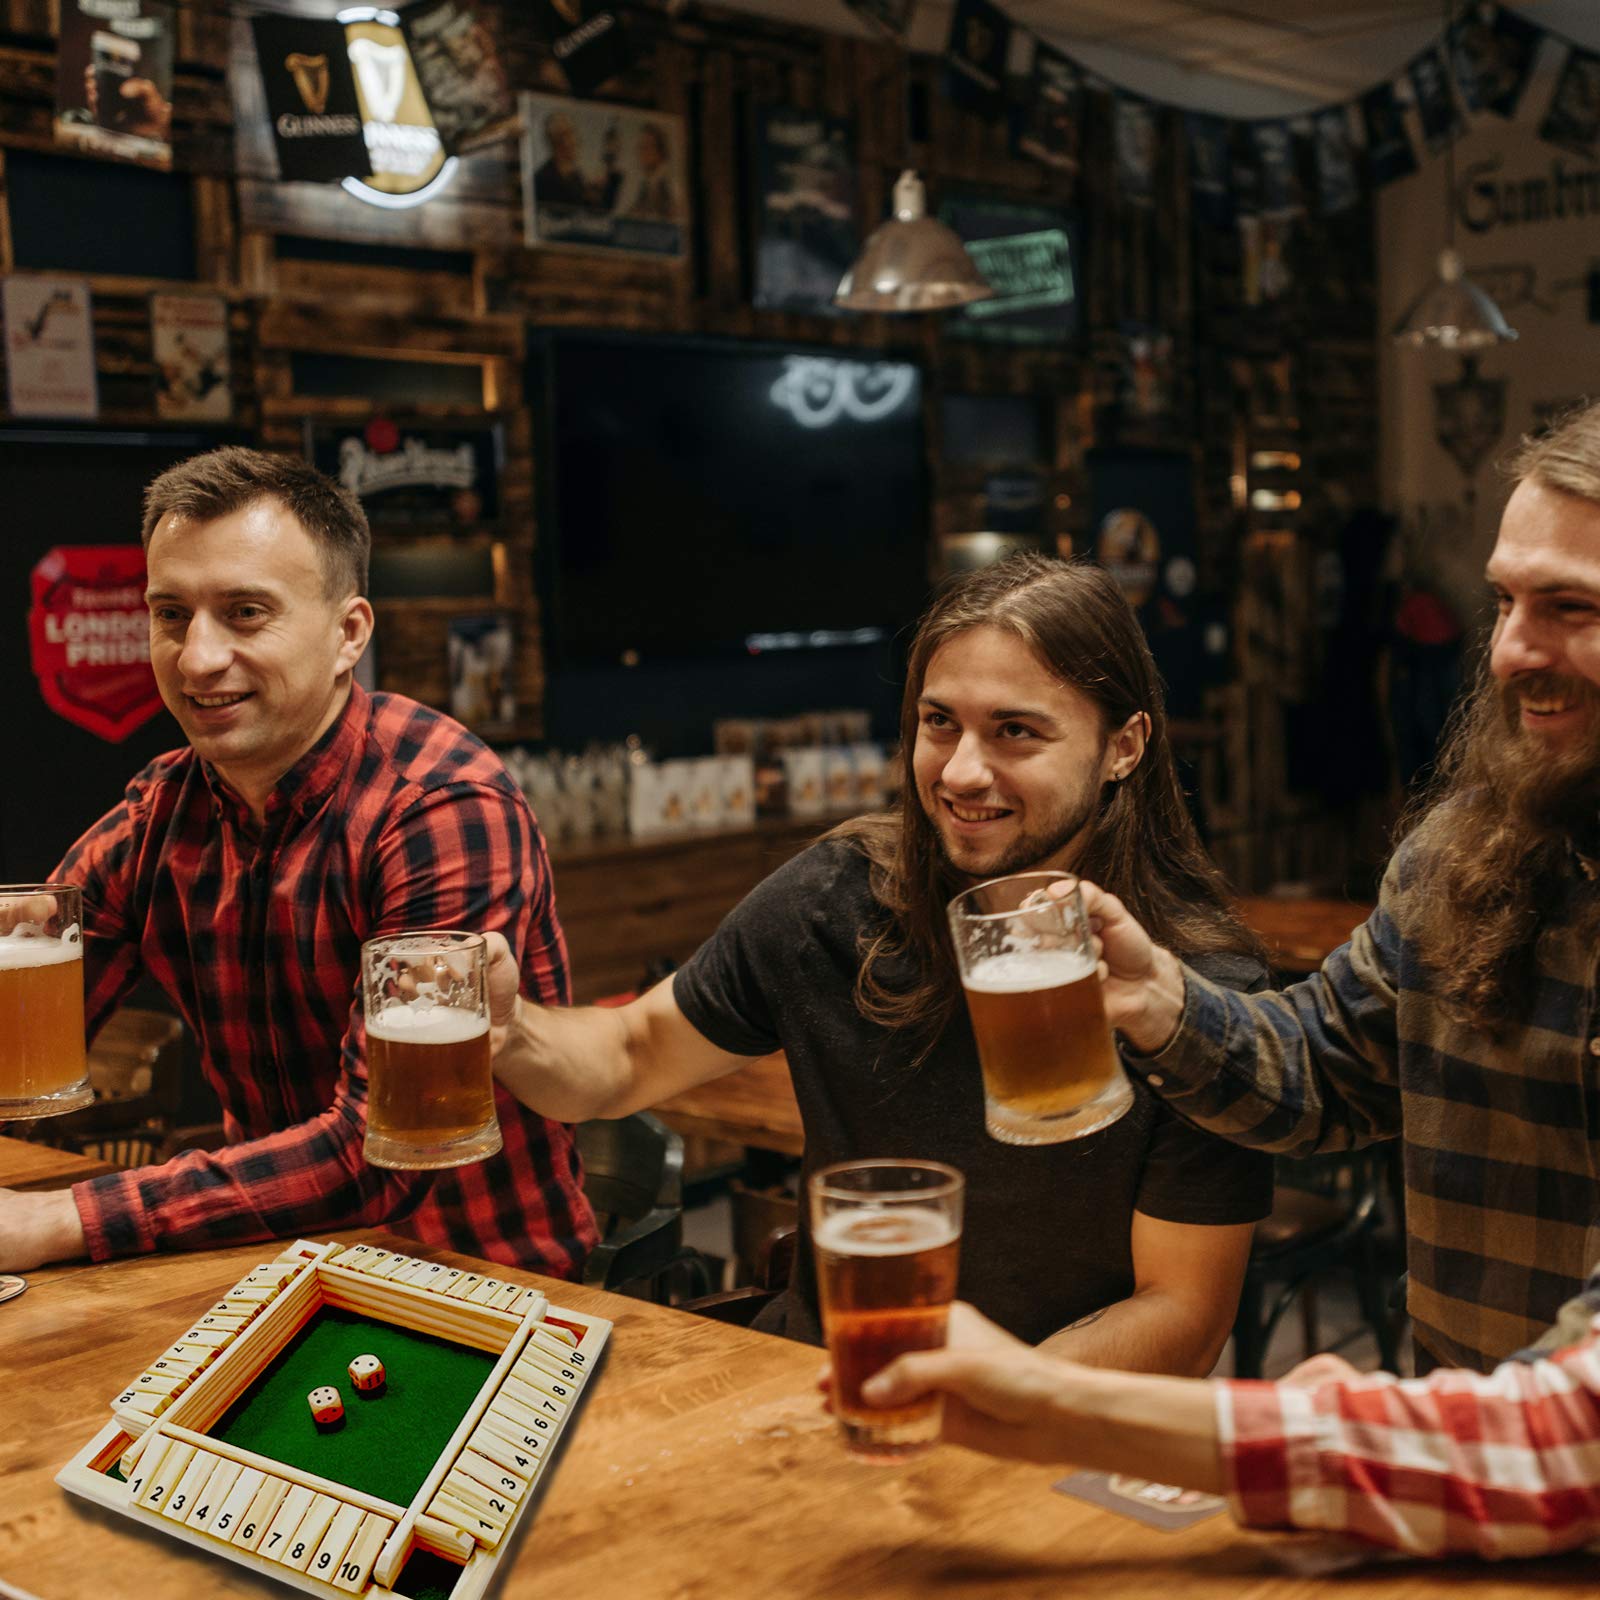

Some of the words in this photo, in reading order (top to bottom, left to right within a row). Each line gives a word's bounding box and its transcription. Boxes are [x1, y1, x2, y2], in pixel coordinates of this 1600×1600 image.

[45, 611, 151, 643] LONDO
[355, 1246, 369, 1254] 10
[155, 1361, 168, 1369] 8
[140, 1376, 153, 1384] 9
[119, 1391, 136, 1404] 10
[479, 1520, 493, 1529] 1
[489, 1499, 505, 1512] 2
[501, 1478, 516, 1489] 3
[515, 1456, 528, 1466] 4
[524, 1436, 538, 1448] 5
[534, 1418, 548, 1429] 6
[543, 1401, 556, 1411] 7
[553, 1386, 566, 1395] 8
[562, 1370, 574, 1379] 9
[570, 1352, 584, 1365] 10
[133, 1479, 142, 1492] 1
[150, 1486, 163, 1501] 2
[173, 1495, 185, 1510] 3
[197, 1505, 209, 1520] 4
[219, 1514, 232, 1529] 5
[243, 1523, 256, 1538] 6
[268, 1533, 282, 1548] 7
[292, 1543, 305, 1559] 8
[318, 1553, 331, 1569] 9
[341, 1562, 360, 1581] 10
